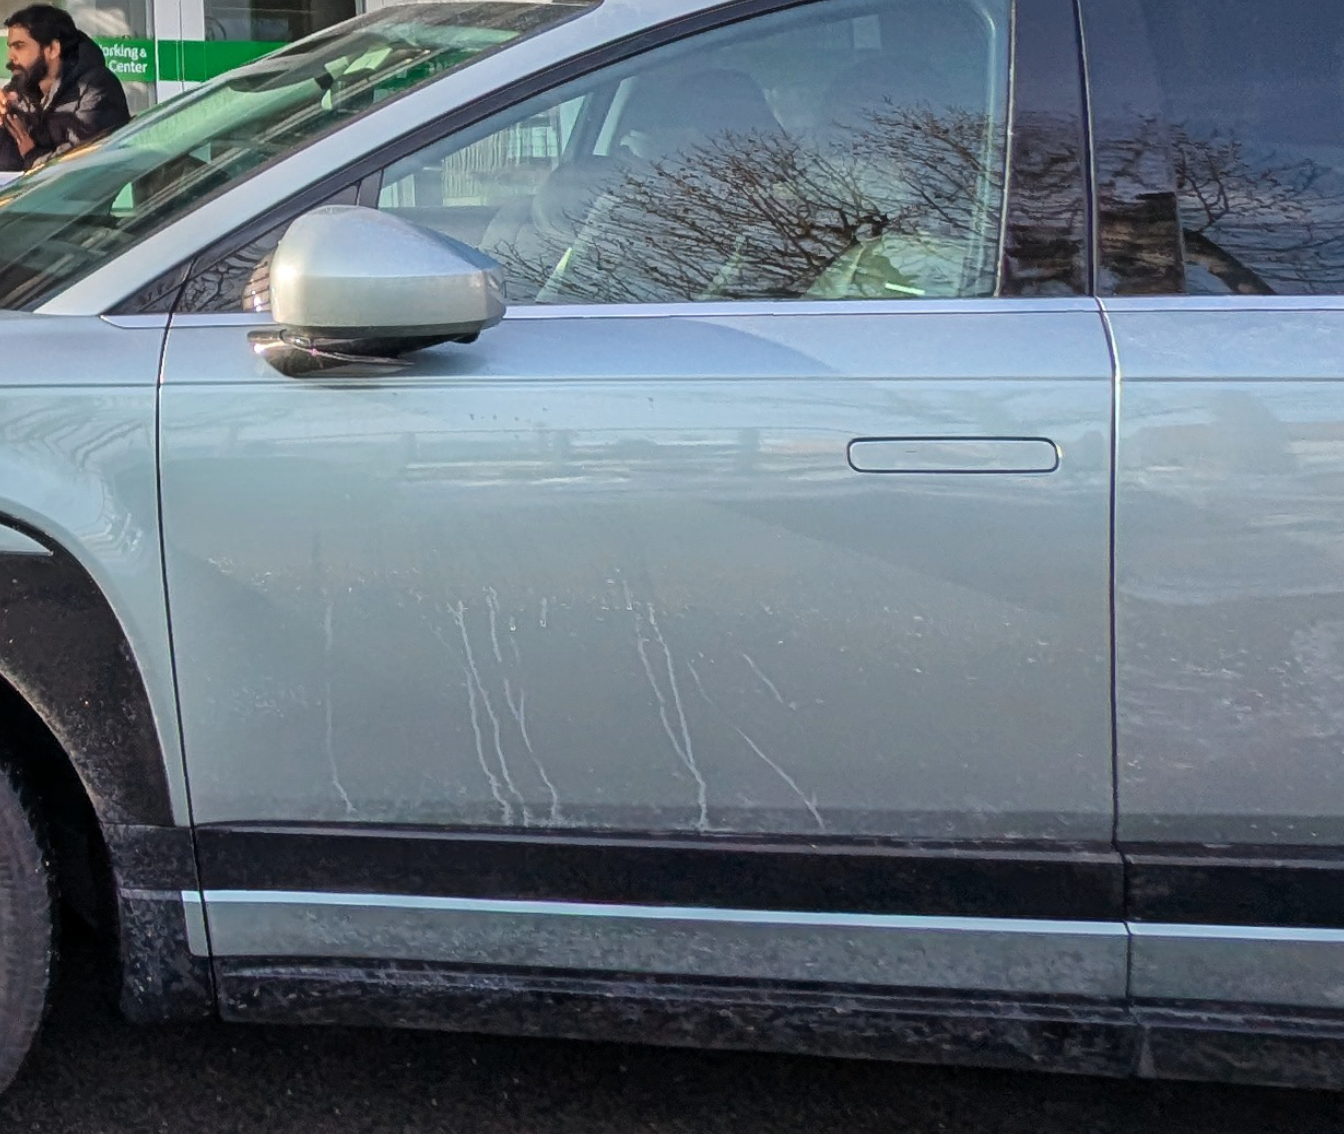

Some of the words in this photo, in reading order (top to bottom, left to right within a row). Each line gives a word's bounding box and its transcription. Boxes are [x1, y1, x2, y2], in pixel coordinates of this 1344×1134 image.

[99, 43, 139, 60] orking
[139, 47, 147, 57] &
[108, 60, 147, 73] Center
